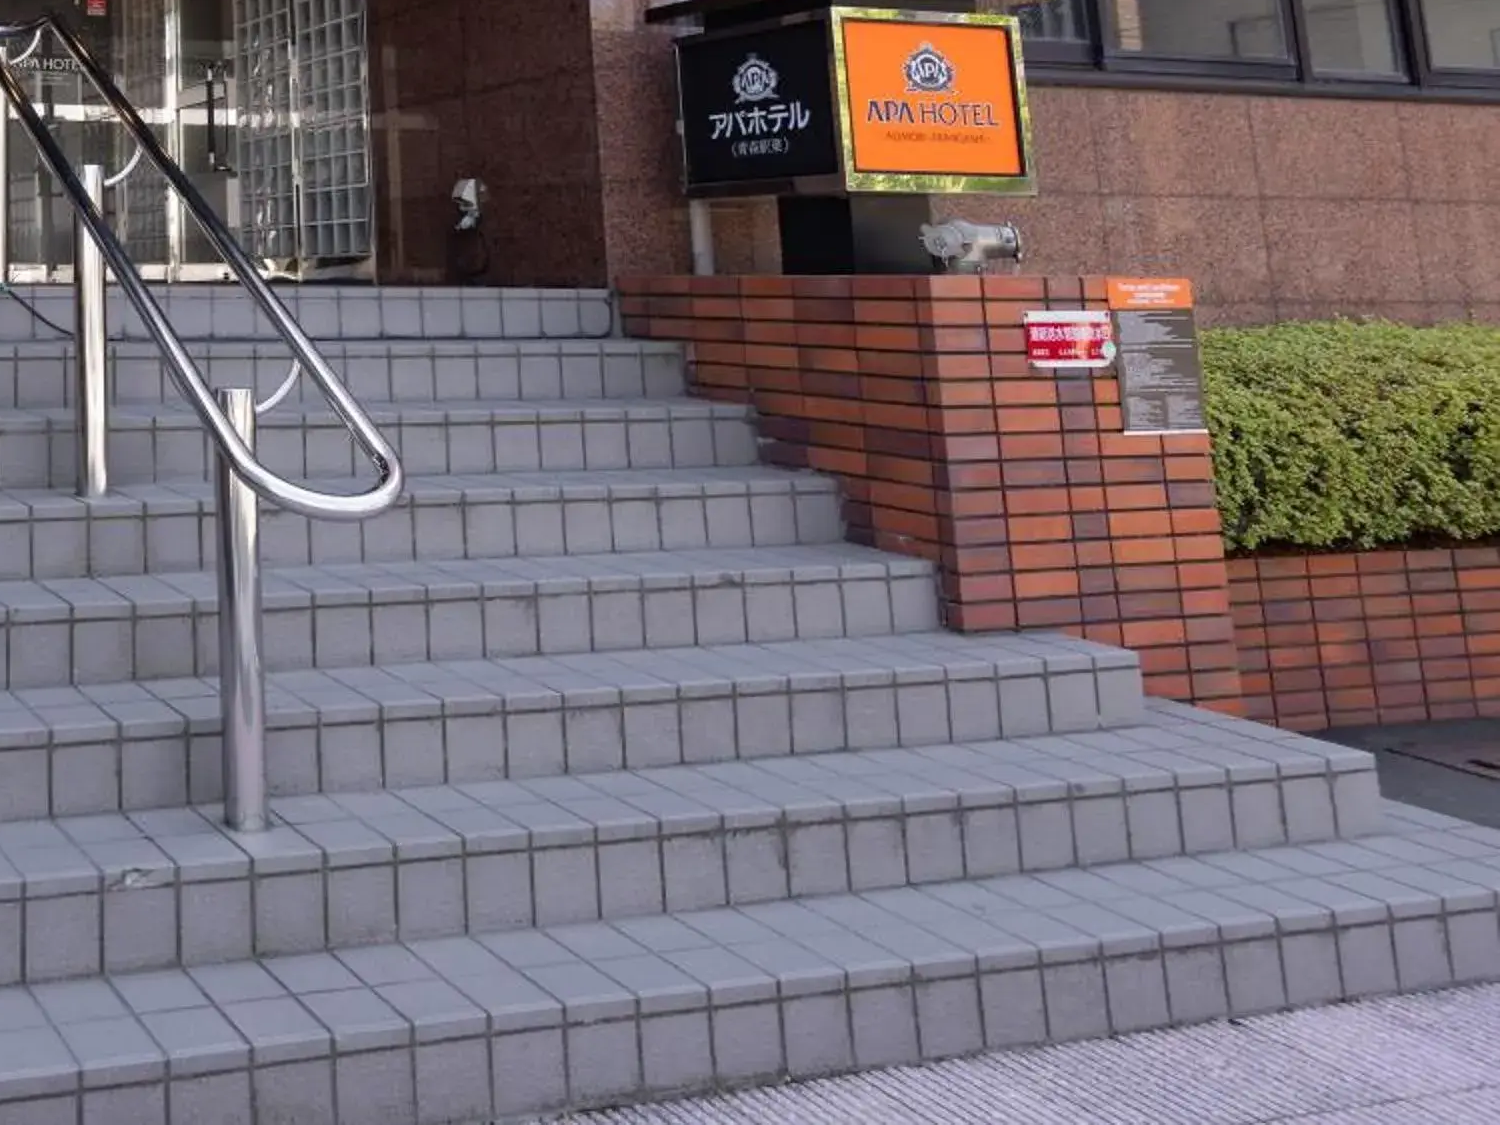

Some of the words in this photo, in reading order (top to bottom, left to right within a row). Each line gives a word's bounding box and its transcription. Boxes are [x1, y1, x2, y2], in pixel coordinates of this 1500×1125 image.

[708, 100, 811, 140] アパホテル
[867, 100, 915, 124] APA
[919, 103, 998, 127] HOTEL
